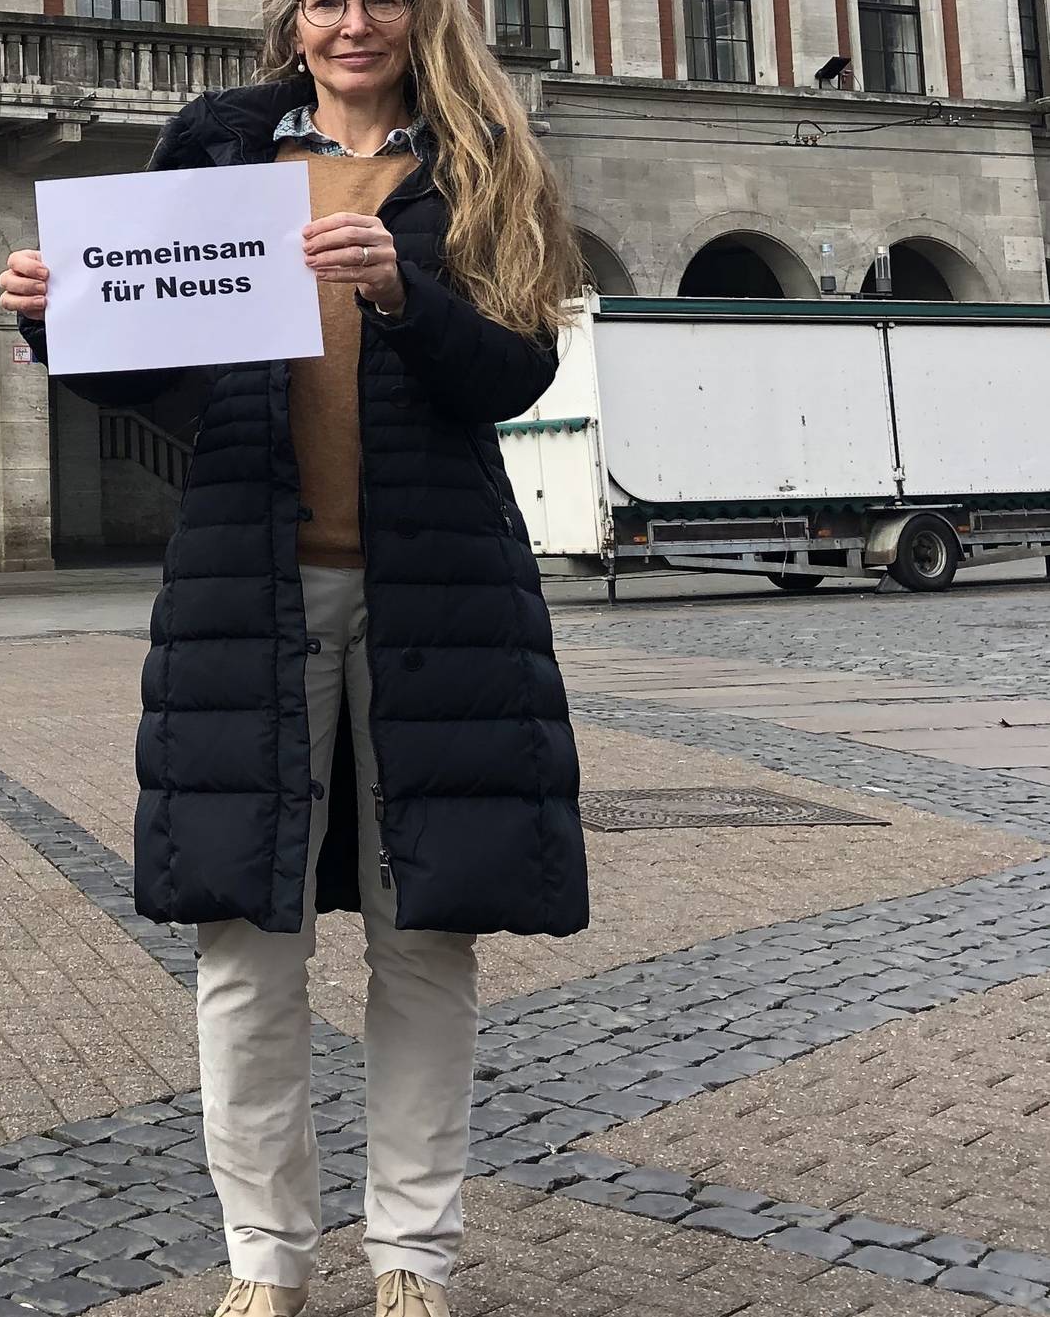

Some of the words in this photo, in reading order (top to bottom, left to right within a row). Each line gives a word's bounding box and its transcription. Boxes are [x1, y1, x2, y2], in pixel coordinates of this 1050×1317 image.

[82, 239, 266, 269] Gemeinsam
[100, 279, 146, 303] für
[155, 275, 252, 299] Neuss
